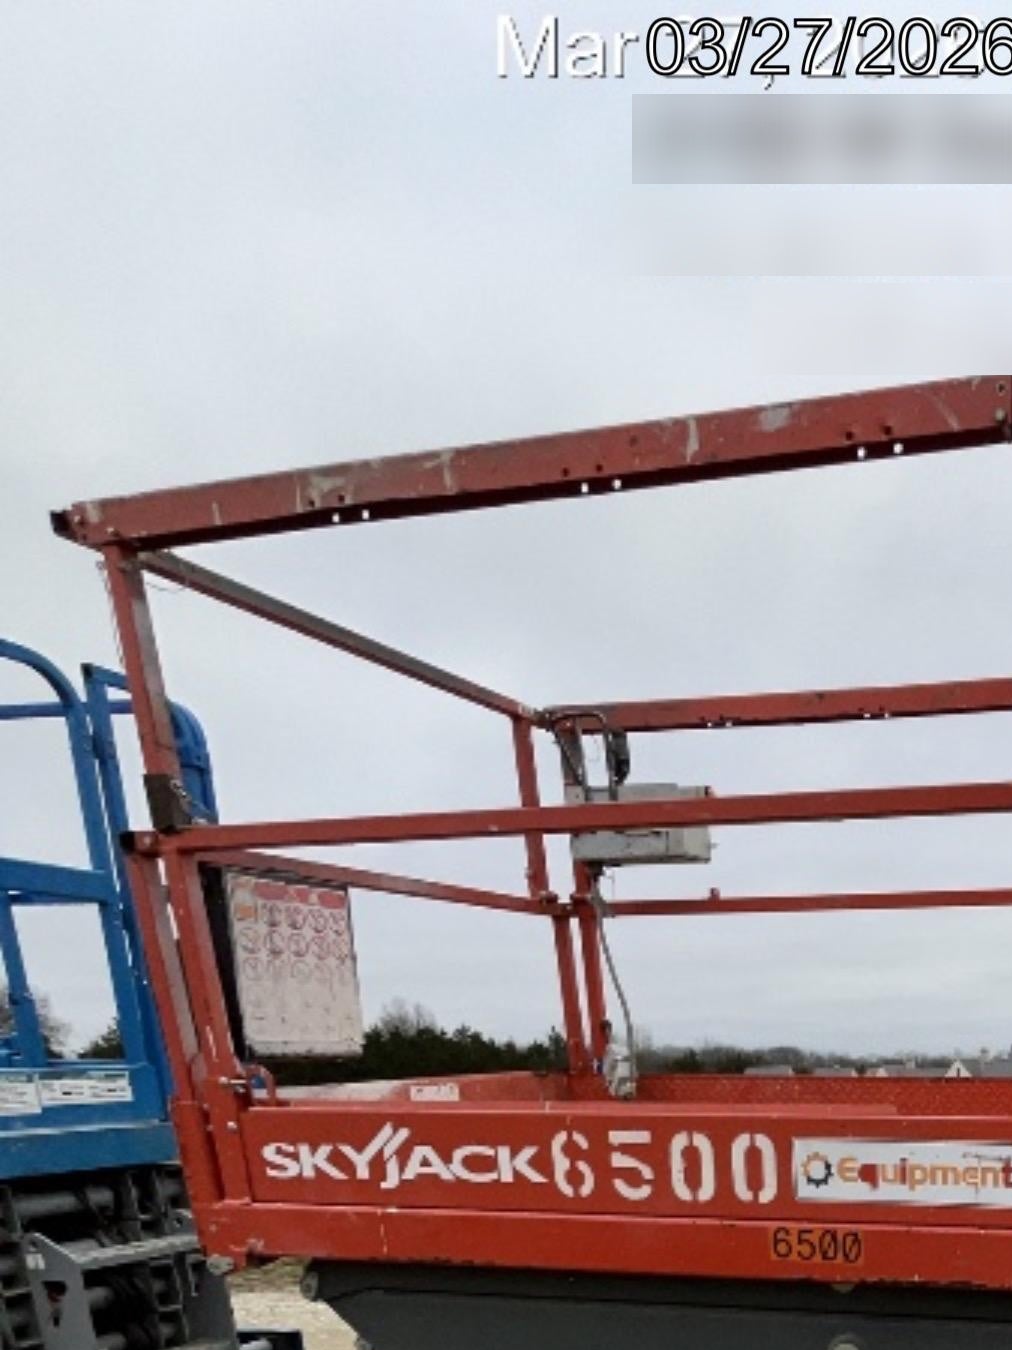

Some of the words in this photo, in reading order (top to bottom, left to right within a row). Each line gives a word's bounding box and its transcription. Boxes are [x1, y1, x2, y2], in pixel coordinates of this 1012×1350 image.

[261, 1121, 549, 1190] SKYJACK
[551, 1130, 778, 1203] 6500
[772, 1226, 862, 1264] 6500
